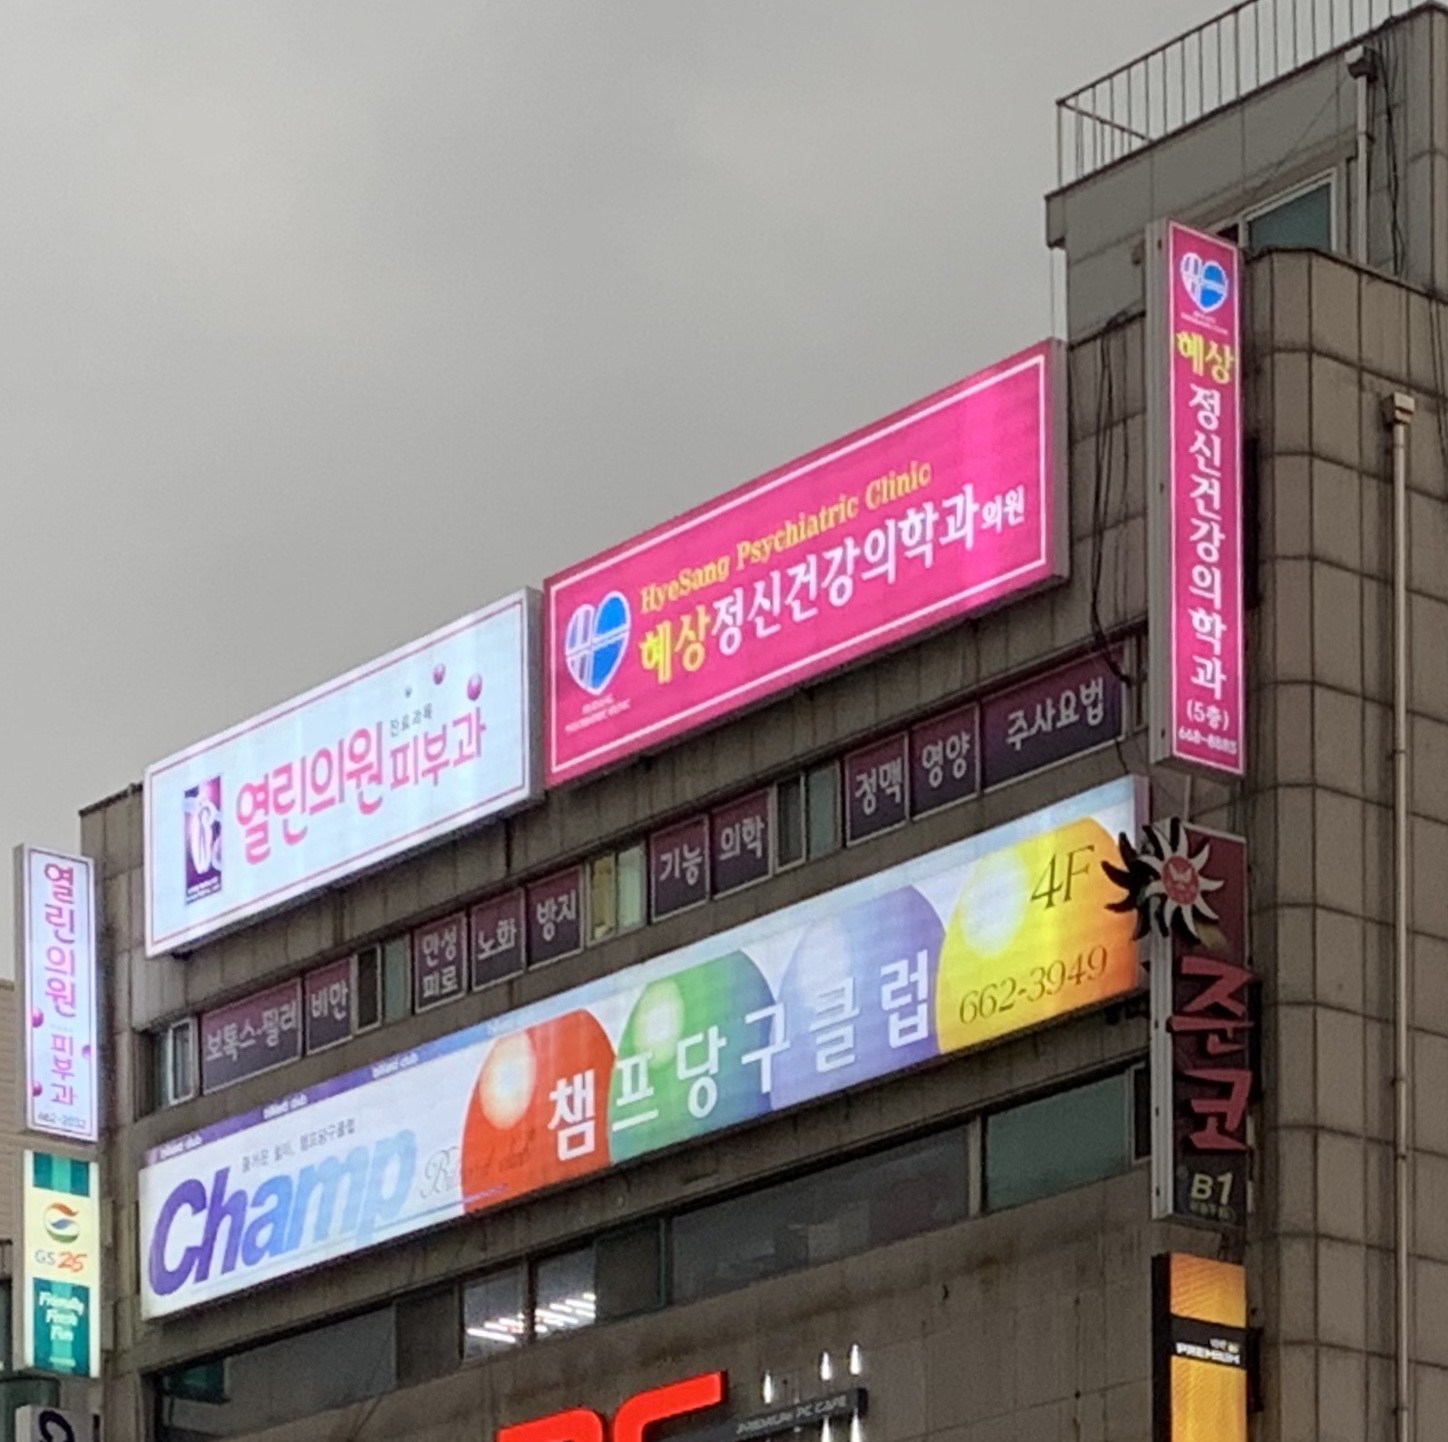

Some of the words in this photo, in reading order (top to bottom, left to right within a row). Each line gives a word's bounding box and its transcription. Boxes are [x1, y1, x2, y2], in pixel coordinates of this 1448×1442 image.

[1176, 330, 1234, 384] 혜상
[640, 556, 730, 614] HyeSang
[736, 495, 859, 567] Psychiatric
[865, 461, 932, 511] Clinic
[1188, 384, 1226, 701] 정신건강의학과
[390, 707, 486, 790] 피부과
[922, 730, 971, 788] 영양
[1006, 677, 1104, 751] 주사요법
[1186, 699, 1229, 731] (5층)
[236, 721, 383, 866] 열린의원
[659, 841, 703, 886] 기능
[719, 815, 765, 861] 의학
[1031, 844, 1096, 909] 4F
[44, 862, 76, 1018] 열린의원
[423, 927, 457, 963] 만성
[477, 920, 517, 961] 노화
[536, 891, 578, 941] 방지
[310, 979, 349, 1020] 비만
[958, 945, 1108, 1028] 662-3949
[51, 1033, 75, 1106] 피부과
[548, 950, 930, 1163] 챔프당구클럽
[1168, 955, 1255, 1151] 준코
[148, 1127, 418, 1297] Champ
[1190, 1171, 1233, 1206] B1
[34, 1249, 88, 1274] GS25
